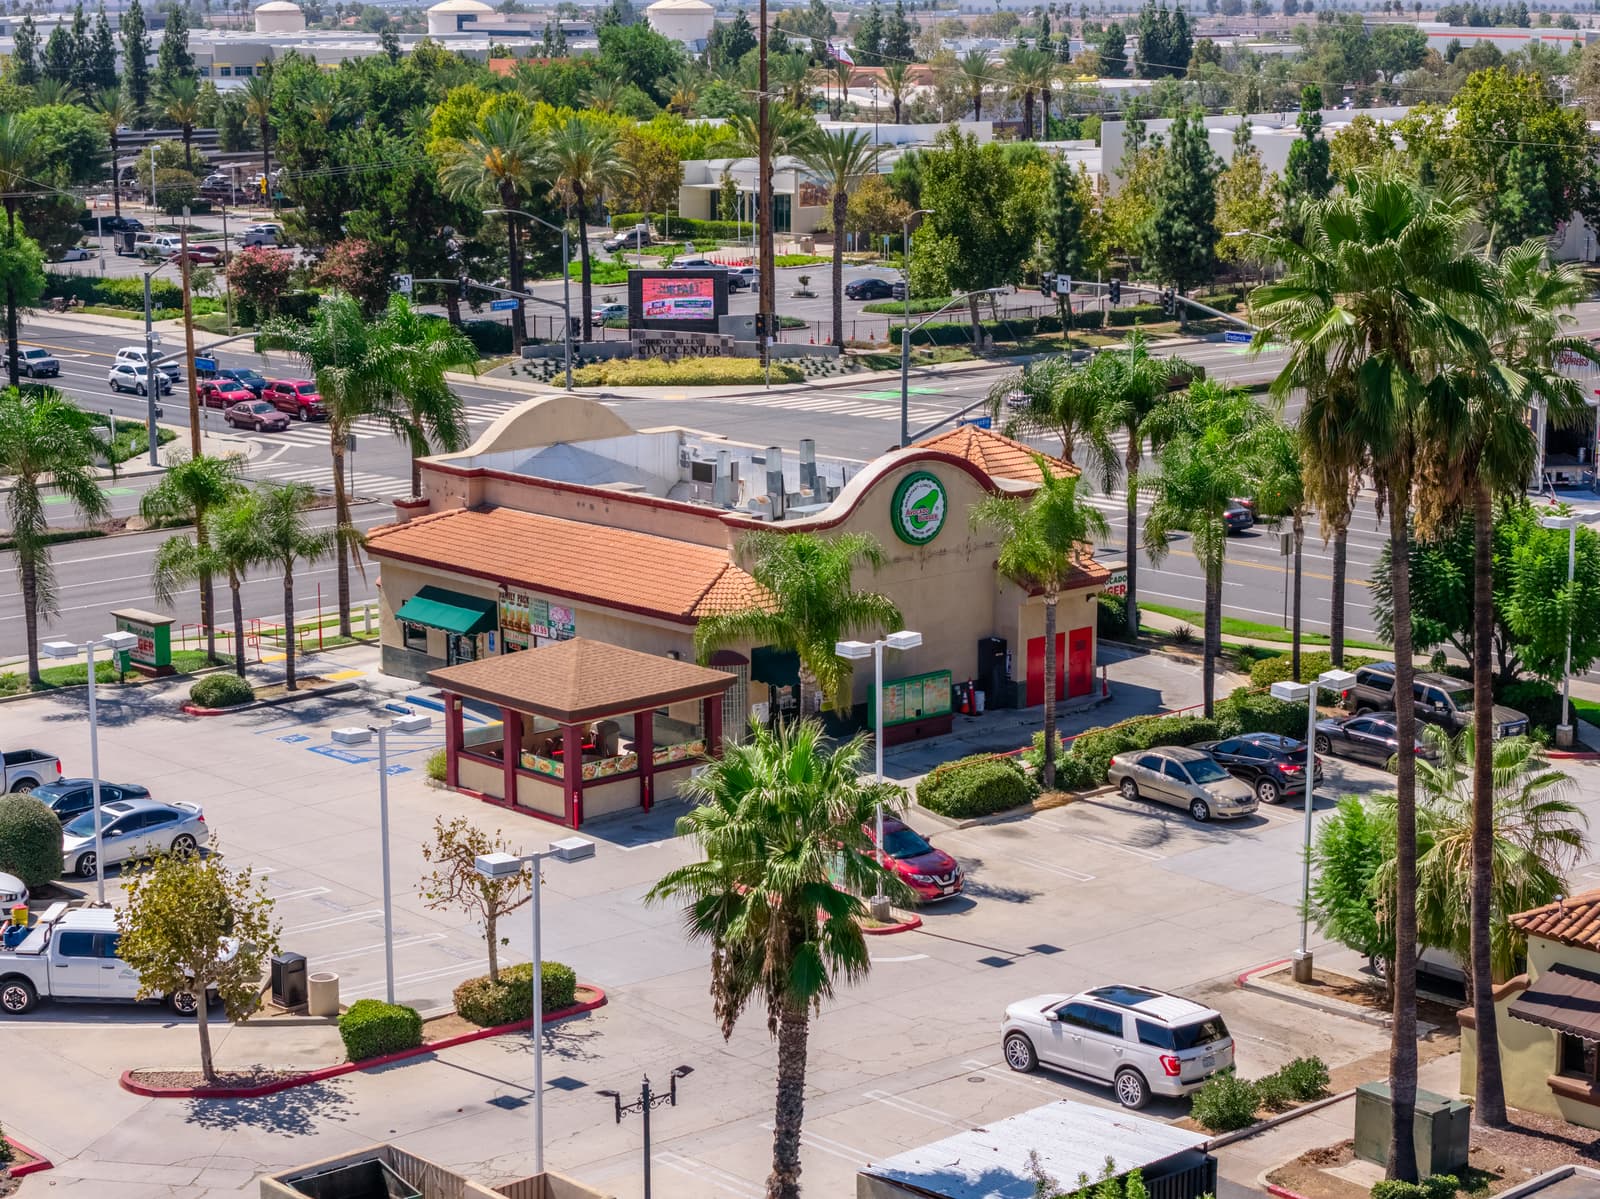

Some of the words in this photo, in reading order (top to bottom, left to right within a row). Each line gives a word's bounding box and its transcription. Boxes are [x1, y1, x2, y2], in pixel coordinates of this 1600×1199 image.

[638, 345, 670, 355] CIVIC
[674, 345, 721, 355] CENTER
[1104, 584, 1127, 596] GER
[500, 591, 515, 601] FAMILY
[517, 593, 530, 603] PACK
[127, 622, 155, 639] AVOCADO
[137, 637, 154, 655] GER
